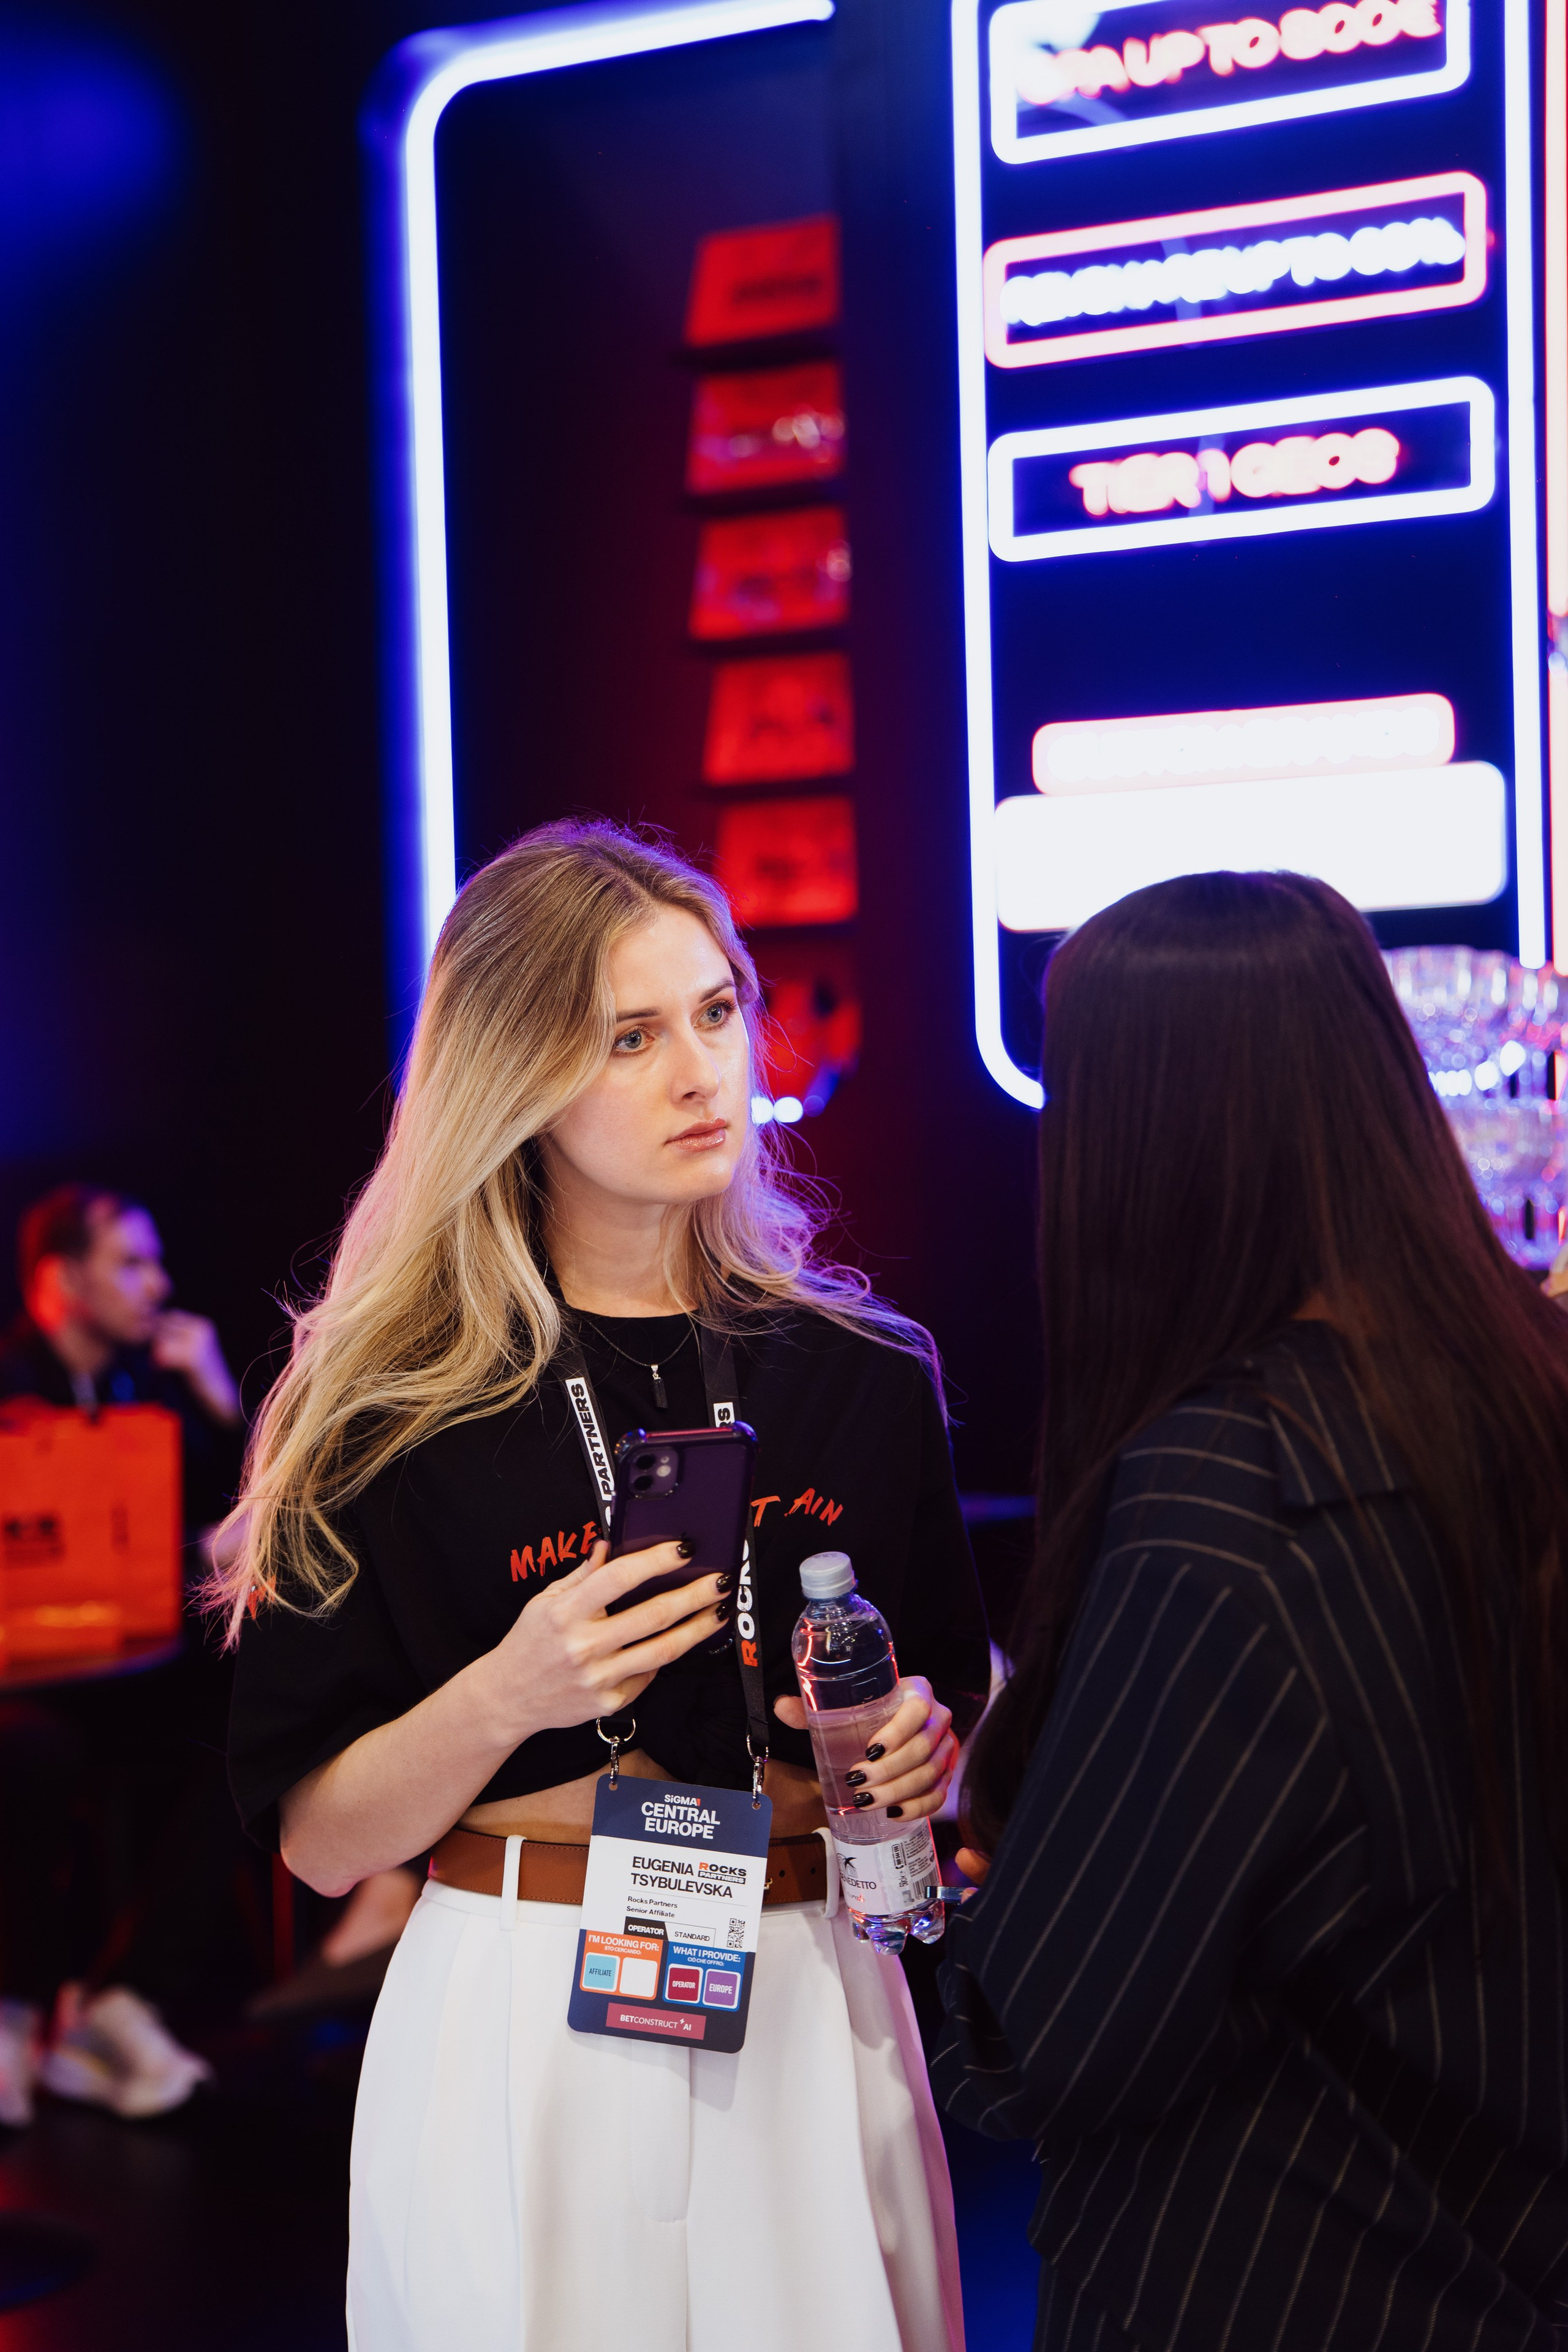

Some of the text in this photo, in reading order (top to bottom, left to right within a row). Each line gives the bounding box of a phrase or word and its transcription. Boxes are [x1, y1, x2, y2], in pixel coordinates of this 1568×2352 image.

[1123, 31, 1205, 87] UP
[1195, 17, 1280, 76] TO
[568, 1382, 613, 1496] PARTNERS
[510, 1520, 598, 1582] MAKE
[641, 1801, 720, 1825] CENTRAL
[645, 1817, 715, 1839] EUROPE
[632, 1856, 747, 1877] EUGENIA ROCKS
[631, 1873, 733, 1898] TSYBULEVSKA
[699, 1871, 744, 1883] PARTNERS
[840, 1872, 876, 1890] ENEDETTO
[627, 1905, 675, 1918] Senior Affiliate
[649, 1899, 677, 1909] Partners
[628, 1924, 710, 1941] OPERATOR STANDARD
[588, 1934, 660, 1951] I'M LOOKING FOR:
[613, 1947, 642, 1955] CERCANDO:
[673, 1945, 698, 1956] WHAT
[703, 1951, 741, 1962] PROVIDE:
[589, 1968, 612, 1977] AFFILIATE
[672, 1980, 696, 1989] OPERATOR
[709, 1983, 733, 1994] EUROPE
[620, 2015, 679, 2029] BETCONSTRUCT
